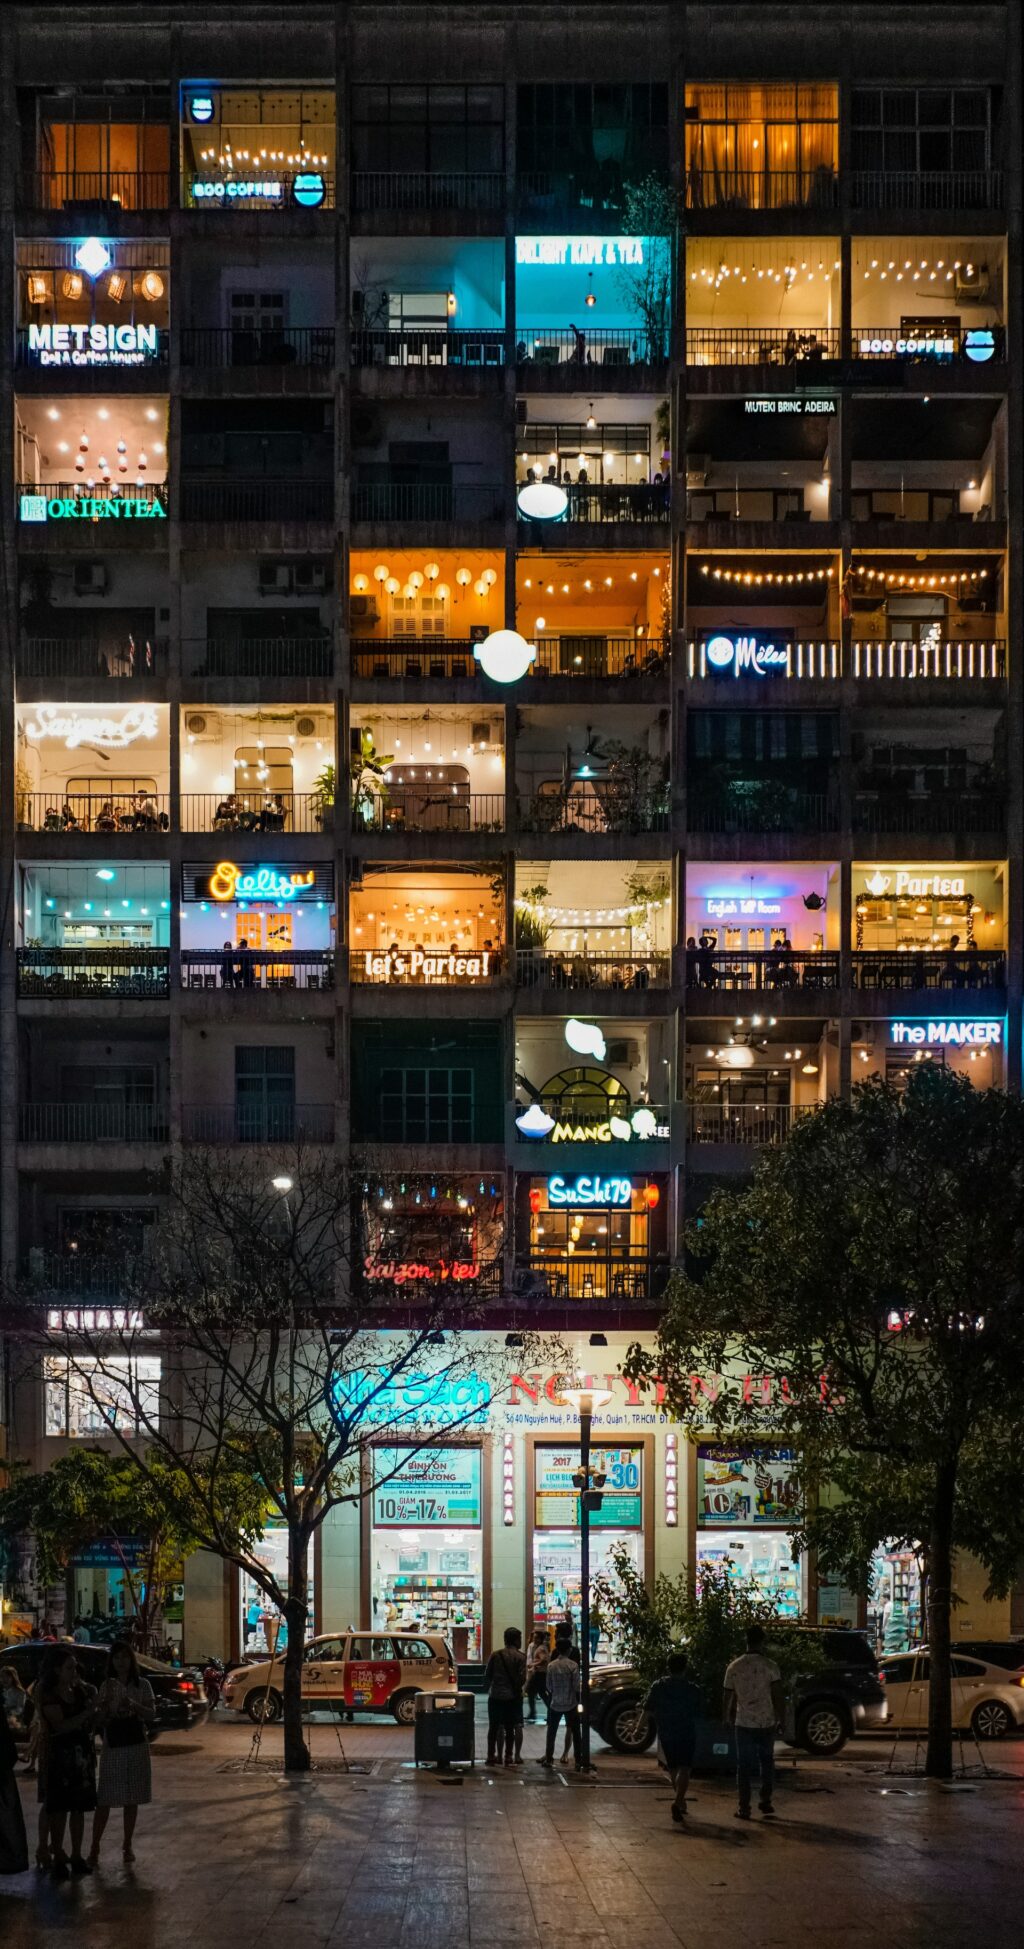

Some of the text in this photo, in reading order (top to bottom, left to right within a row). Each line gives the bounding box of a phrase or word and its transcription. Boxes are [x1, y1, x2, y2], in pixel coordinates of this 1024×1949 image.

[194, 182, 281, 197] BOO COFFEE
[29, 324, 156, 350] METSIGN
[860, 340, 954, 353] BOO COFFEE
[110, 350, 145, 364] House
[745, 402, 776, 412] MUTEKI
[805, 402, 835, 412] ADEIRA
[48, 498, 166, 518] ORIENTEA
[896, 871, 966, 895] Partea
[708, 900, 737, 918] English
[758, 900, 780, 913] Room
[366, 951, 489, 977] let's Partea!
[892, 1023, 1000, 1043] the MAKER
[362, 1256, 434, 1285] Saigon
[404, 1368, 490, 1405] Sách
[515, 1414, 523, 1423] 40
[632, 1414, 656, 1424] TP.HCM
[553, 1457, 571, 1466] 2017
[504, 1434, 514, 1521] FAHASA
[666, 1434, 676, 1522] FAHASA
